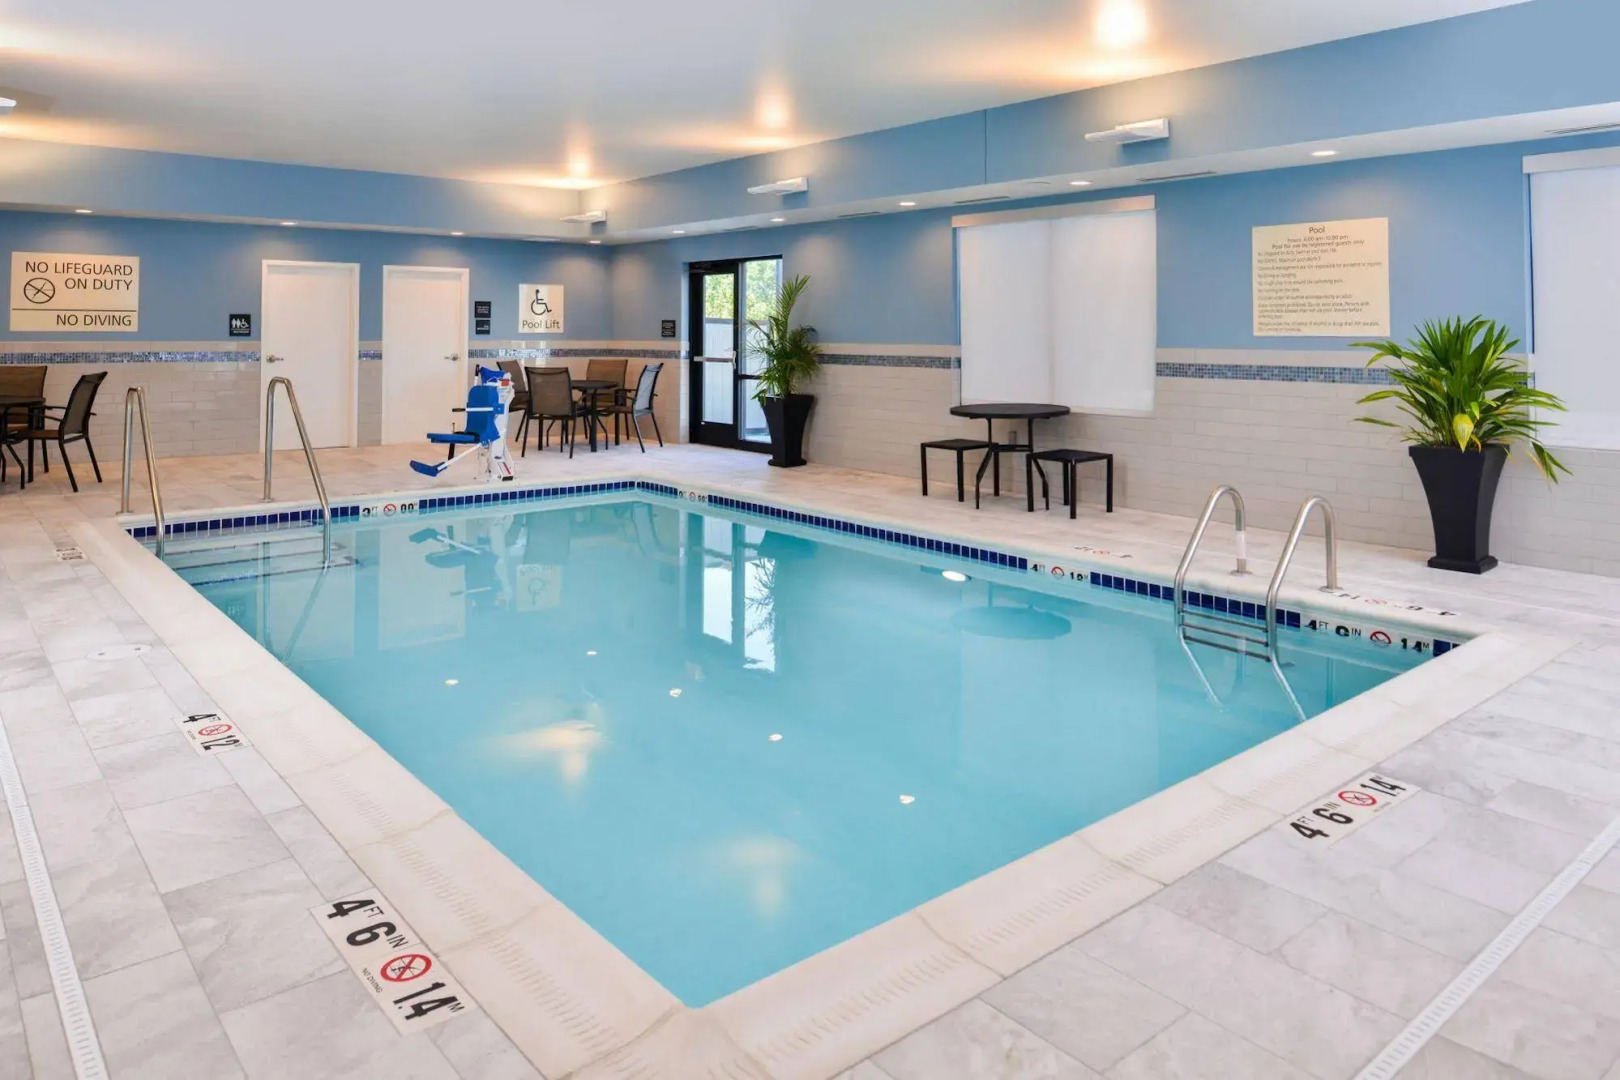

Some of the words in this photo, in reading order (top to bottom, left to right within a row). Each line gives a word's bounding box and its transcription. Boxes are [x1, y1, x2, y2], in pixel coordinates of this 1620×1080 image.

[25, 261, 48, 273] NO
[54, 262, 133, 276] LIFEGUARD
[64, 278, 87, 290] ON
[93, 279, 133, 290] DUTY
[56, 314, 78, 326] NO
[84, 314, 131, 326] DIVING
[522, 320, 542, 328] Pool
[545, 320, 560, 329] Lift
[1319, 621, 1329, 630] FT
[1352, 628, 1361, 637] IN
[183, 714, 217, 723] 4
[1290, 822, 1330, 839] 4
[1312, 808, 1354, 824] 6
[326, 899, 376, 919] 4
[363, 906, 384, 918] FT
[346, 921, 396, 946] 6
[387, 934, 409, 948] IN
[448, 1002, 465, 1013] M
